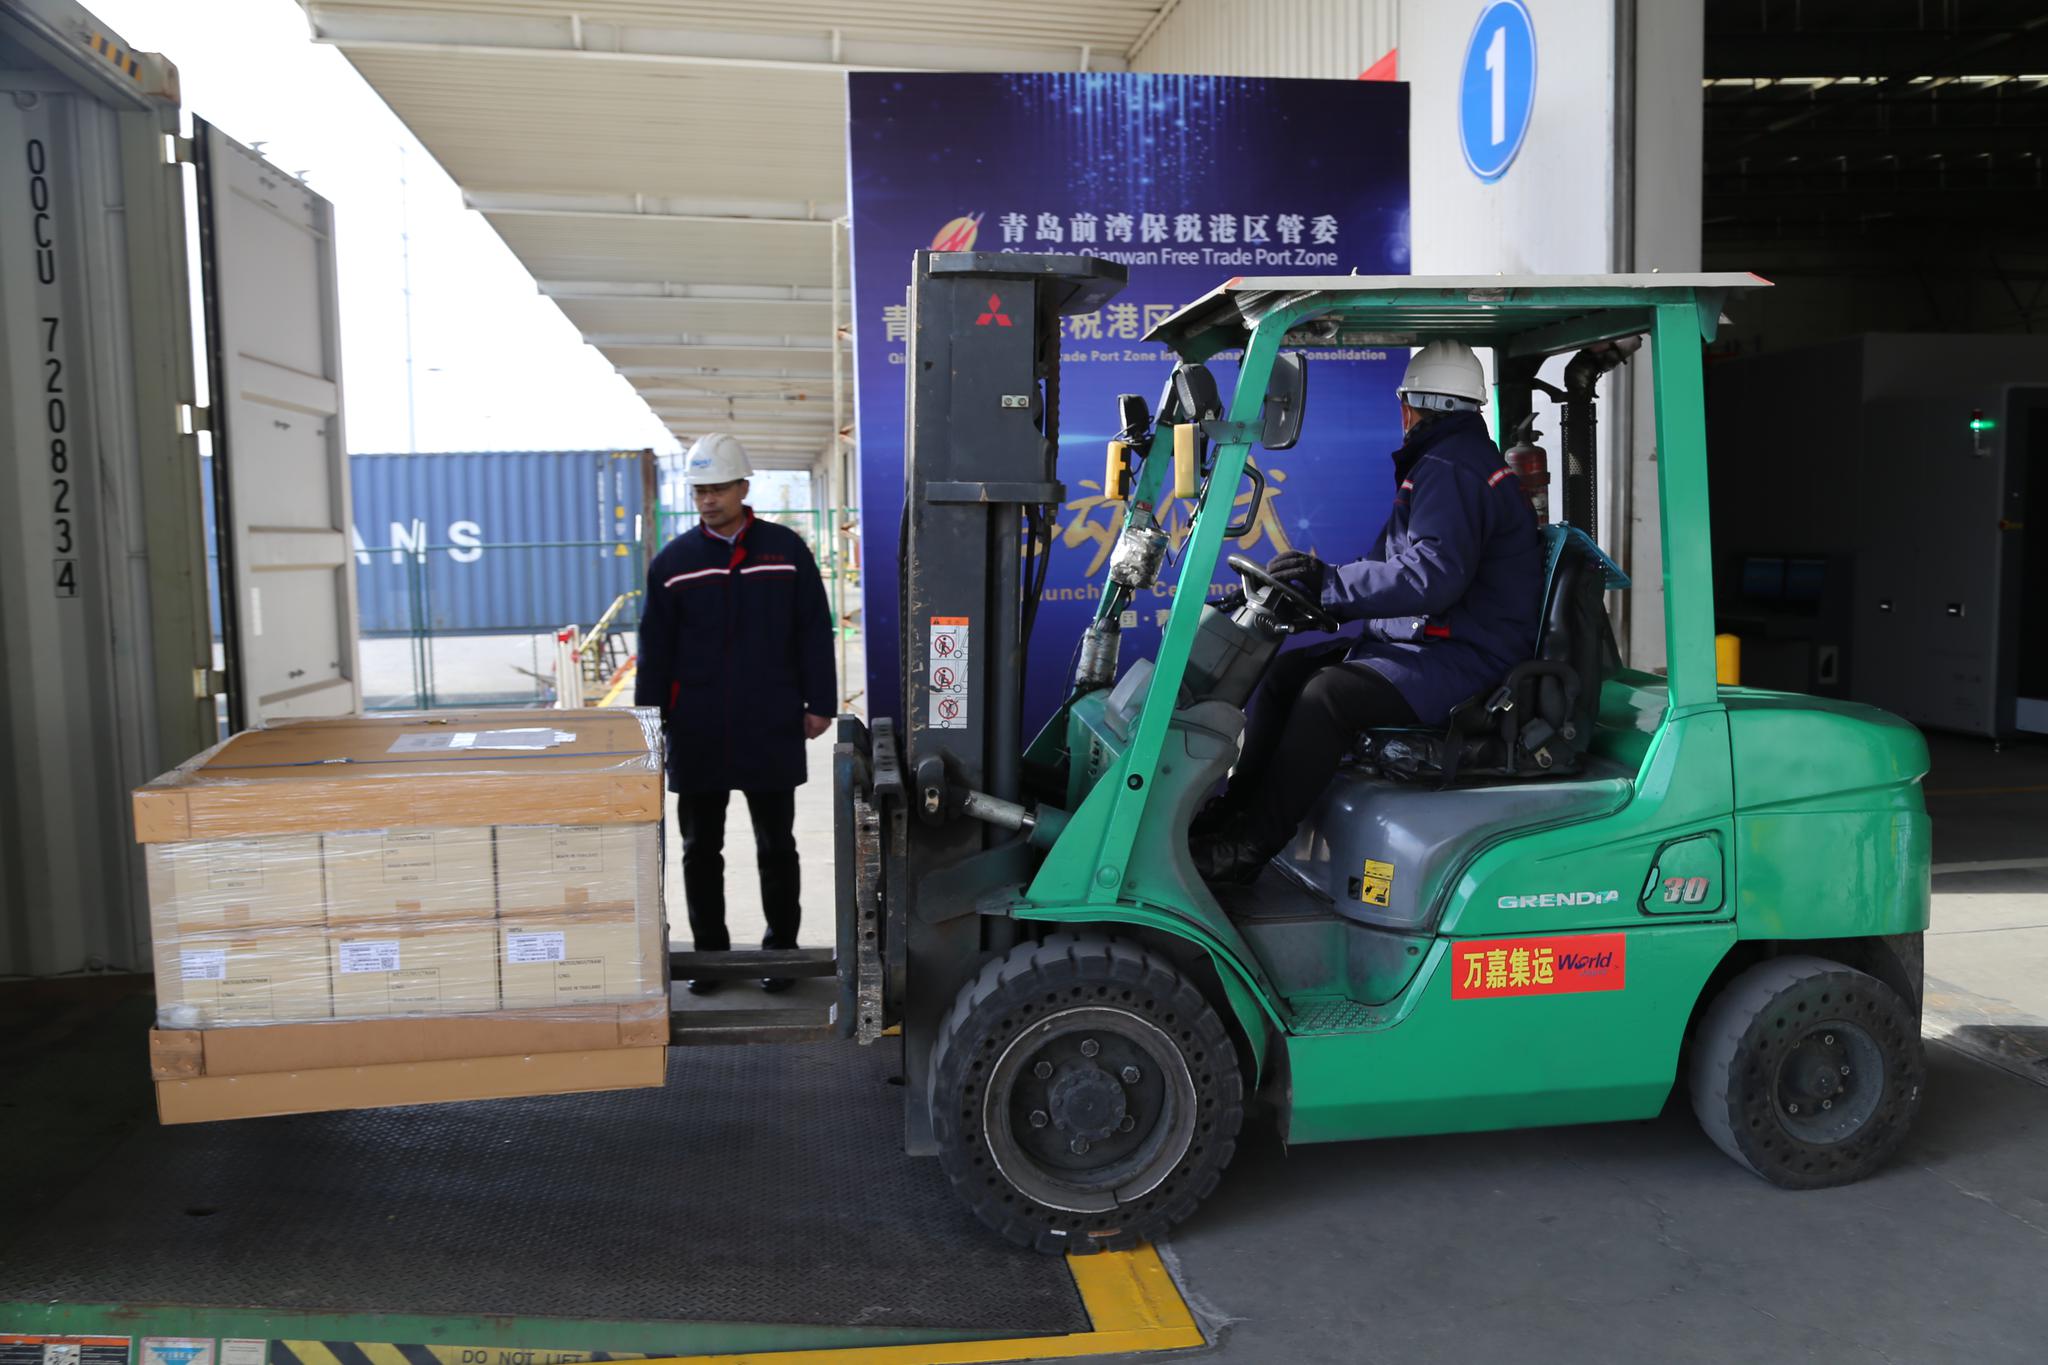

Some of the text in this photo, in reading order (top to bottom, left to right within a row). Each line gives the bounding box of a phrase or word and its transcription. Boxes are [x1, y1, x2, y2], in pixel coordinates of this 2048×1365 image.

[1485, 26, 1506, 146] 1
[998, 212, 1340, 245] 青岛前湾保税港区管委
[1161, 249, 1199, 265] Free
[1201, 249, 1253, 265] Trade
[1255, 249, 1293, 265] Port
[1295, 249, 1338, 267] Zone
[1092, 350, 1120, 361] Port
[1123, 351, 1157, 361] Zone
[1663, 877, 1709, 904] 30
[1463, 947, 1554, 989] 万嘉集运
[1558, 951, 1613, 970] World
[462, 1350, 488, 1364] DO
[500, 1351, 535, 1365] NOT
